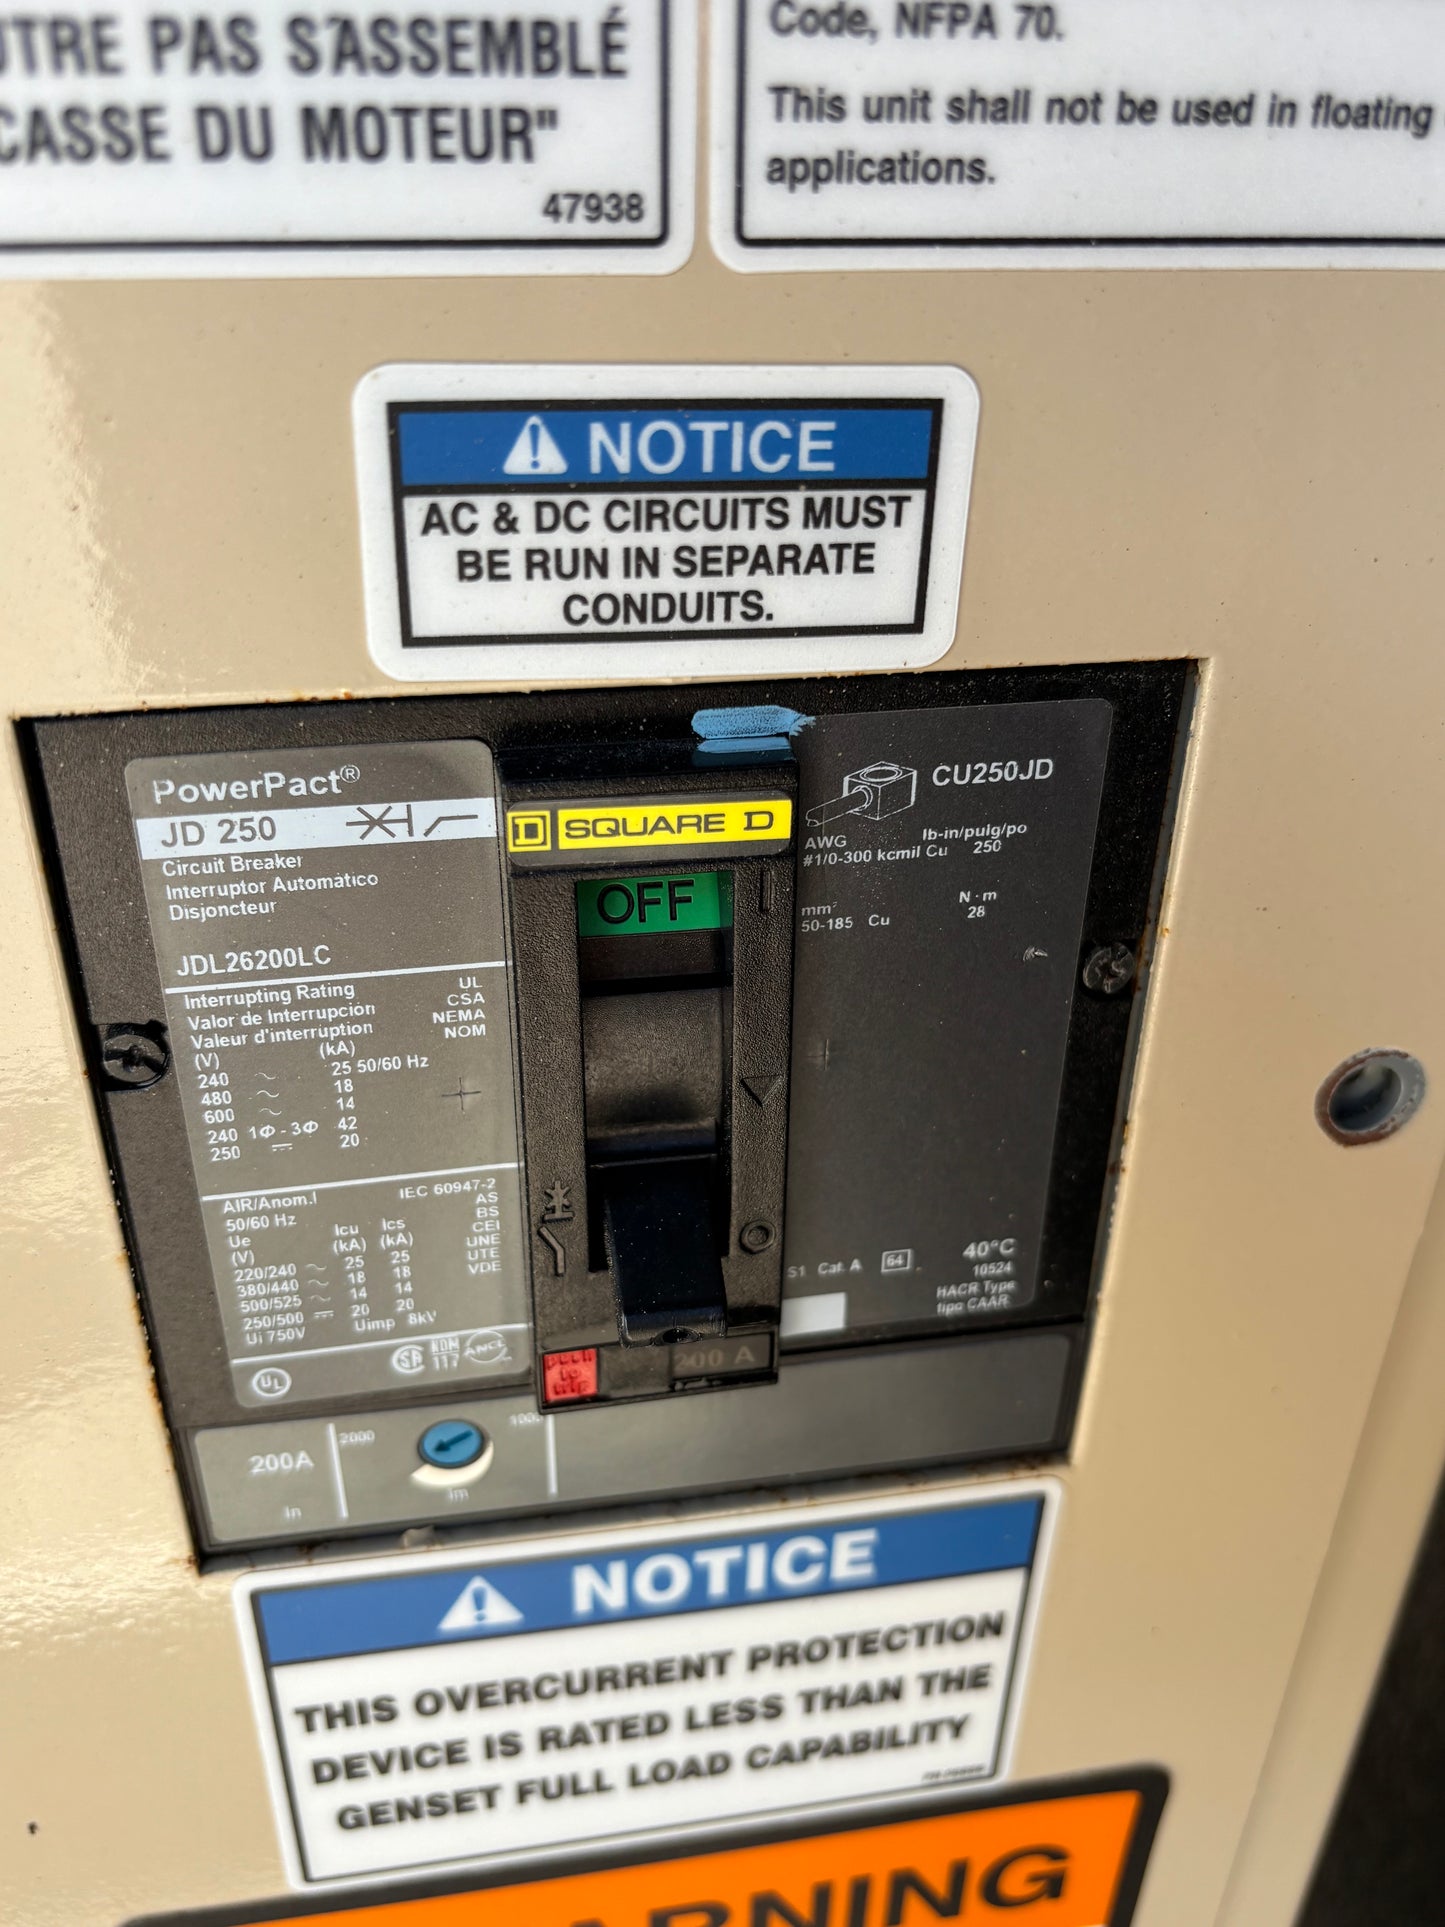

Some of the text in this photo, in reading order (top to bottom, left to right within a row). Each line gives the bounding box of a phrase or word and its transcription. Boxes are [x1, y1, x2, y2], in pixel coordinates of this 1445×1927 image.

[769, 2, 1064, 43] Code, NFPA 70.
[0, 17, 122, 75] TRE
[147, 16, 262, 76] PAS
[769, 86, 1433, 138] This unit shall not be used in floating
[197, 105, 274, 163] DU
[303, 106, 559, 165] MOTEUR"
[767, 150, 996, 193] applications.
[542, 193, 645, 223] 47938
[590, 421, 836, 475] NOTICE
[421, 496, 911, 536] AC & DC CIRCUITS MUST
[458, 543, 875, 581] BE RUN IN SEPARATE
[563, 590, 773, 626] CONDUITS.
[932, 759, 1054, 787] CU250JD
[161, 816, 276, 847] JD 250
[565, 811, 774, 839] SQUARE D
[923, 823, 1027, 842] lb-in/pulg/po
[805, 835, 847, 850] AWG
[973, 840, 1002, 854] 250
[162, 854, 303, 877] Circuit Breaker
[803, 845, 948, 868] #1/0-300 kcmil Cu
[166, 881, 266, 901] Interruptor
[598, 879, 694, 924] OFF
[169, 900, 277, 922] Disjoncteur
[967, 906, 985, 919] 28
[801, 914, 890, 932] 50-185 Cu
[177, 944, 331, 977] JDL26200LC
[459, 976, 483, 989] UL
[184, 982, 355, 1010] Interrupting Rating
[447, 992, 486, 1006] CSA
[188, 1014, 234, 1031] Valor
[241, 1011, 262, 1026] de
[432, 1009, 486, 1024] NEMA
[191, 1021, 373, 1049] Valeur d'interruption
[444, 1024, 487, 1039] NOM
[320, 1040, 356, 1060] (kA)
[195, 1053, 220, 1070] (V)
[331, 1054, 429, 1076] 25 50/60 Hz
[198, 1073, 229, 1089] 240
[334, 1078, 354, 1093] 18
[201, 1090, 232, 1106] 480
[336, 1096, 356, 1111] 14
[204, 1108, 235, 1124] 600
[337, 1116, 358, 1131] 42
[208, 1128, 238, 1144] 240
[340, 1133, 360, 1148] 20
[210, 1145, 241, 1162] 250
[400, 1178, 496, 1199] IEC 60947-2
[475, 1192, 499, 1204] AS
[476, 1206, 500, 1218] BS
[226, 1213, 297, 1232] 50/60 Hz
[472, 1220, 500, 1232] CEI
[229, 1235, 251, 1248] Ue
[333, 1237, 366, 1256] (kA)
[381, 1231, 413, 1250] (kA)
[466, 1233, 501, 1247] UNE
[962, 1237, 1017, 1258] 40°C
[231, 1250, 255, 1267] (V)
[345, 1255, 365, 1269] 25
[391, 1250, 410, 1264] 25
[467, 1247, 500, 1260] UTE
[234, 1263, 297, 1282] 220/240
[393, 1265, 411, 1279] 18
[468, 1260, 502, 1274] VDE
[972, 1260, 1012, 1277] 10524
[347, 1271, 366, 1284] 18
[236, 1279, 299, 1298] 380/440
[350, 1286, 368, 1300] 14
[395, 1281, 413, 1295] 14
[240, 1295, 302, 1313] 500/525
[351, 1303, 370, 1317] 20
[396, 1298, 415, 1312] 20
[243, 1311, 304, 1330] 250/500
[354, 1317, 396, 1333] Uimp
[266, 1326, 306, 1343] 750V
[675, 1349, 722, 1370] 200
[339, 1430, 375, 1445] 2000
[250, 1450, 315, 1474] 200A
[571, 1528, 879, 1615] NOTICE
[294, 1611, 1007, 1734] THIS OVERCURRENT PROTECTION
[311, 1663, 992, 1784] DEVICE IS RATED LESS THAN THE
[337, 1714, 971, 1831] GENSET FULL LOAD CAPABILITY
